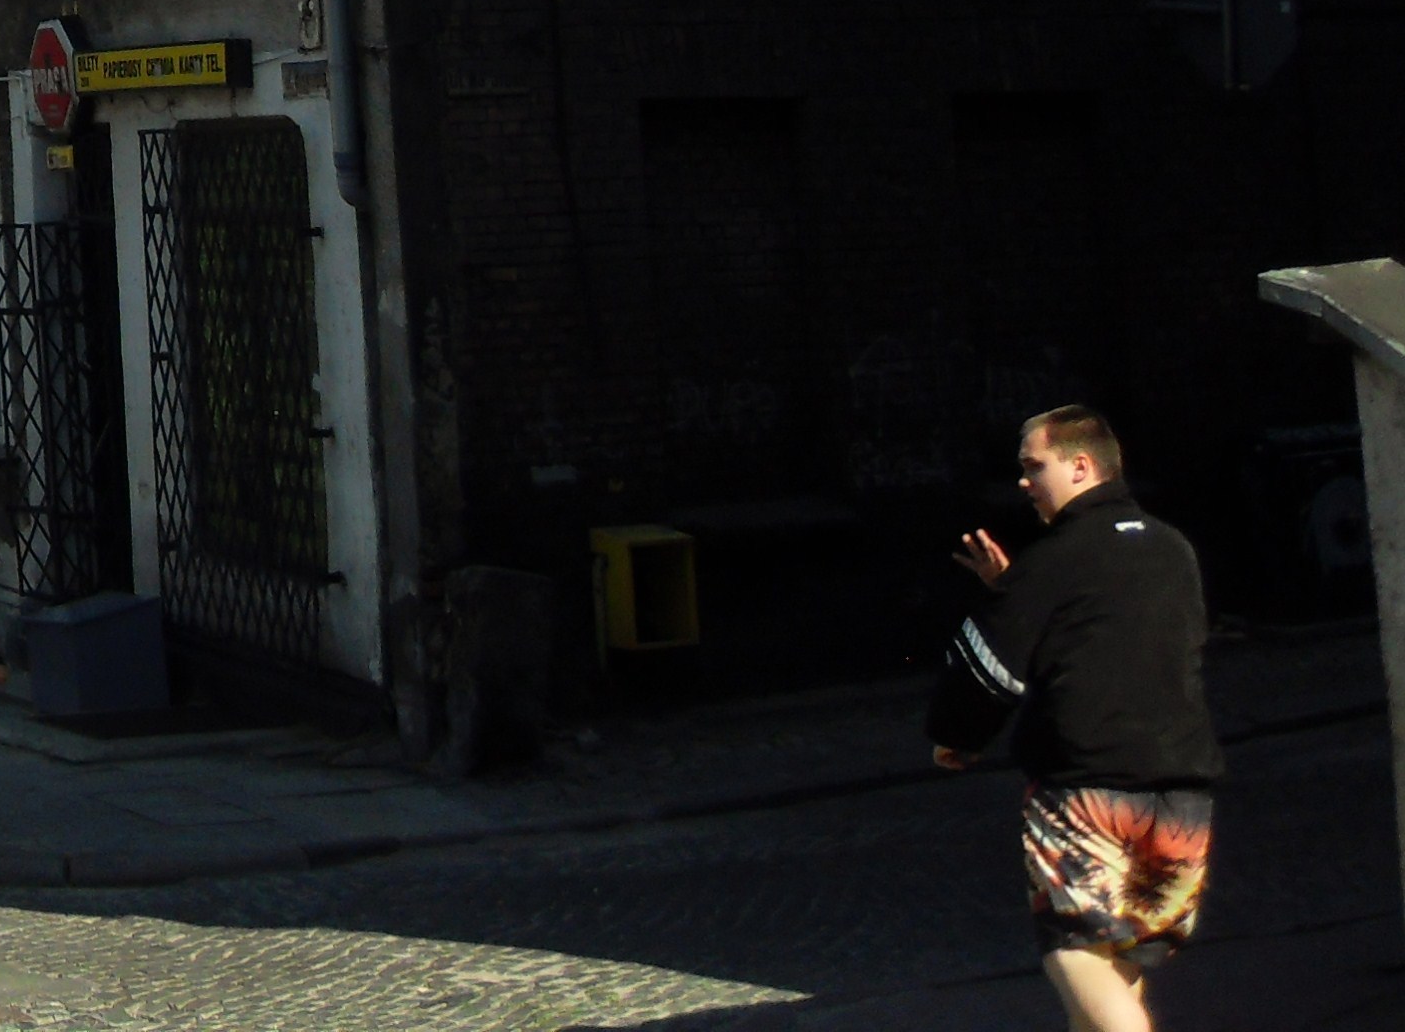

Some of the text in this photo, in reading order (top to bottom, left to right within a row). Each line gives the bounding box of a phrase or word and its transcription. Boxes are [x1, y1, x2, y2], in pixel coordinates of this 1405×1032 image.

[103, 58, 142, 79] PAPIEROSY
[179, 54, 203, 74] KARTY
[205, 53, 223, 73] TEL.
